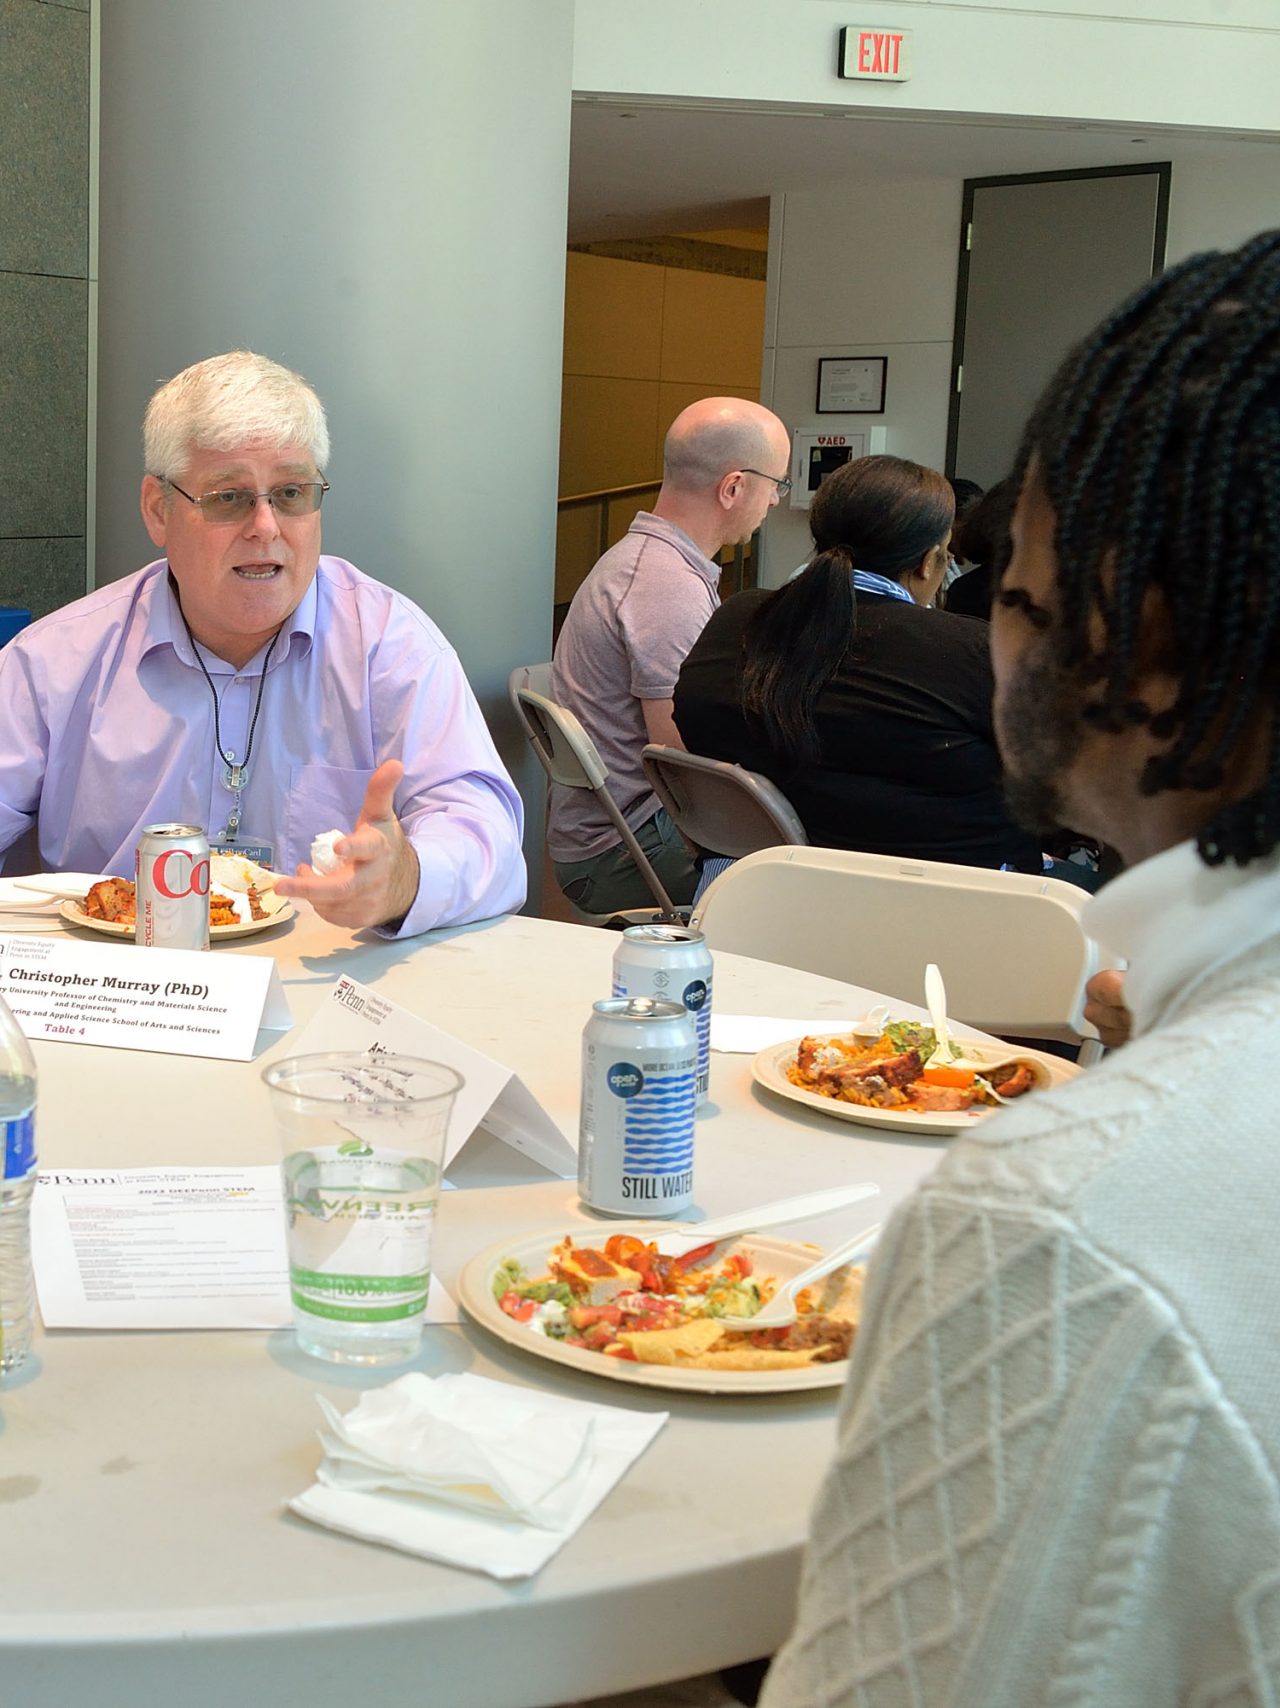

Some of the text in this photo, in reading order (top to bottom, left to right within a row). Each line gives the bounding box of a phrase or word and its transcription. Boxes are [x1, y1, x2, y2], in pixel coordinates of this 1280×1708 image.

[858, 31, 904, 74] EXIT
[826, 436, 846, 445] AED
[146, 900, 152, 912] ME
[9, 968, 209, 1000] Christopher Murray (PhD)
[9, 987, 48, 997] University
[50, 991, 86, 1000] Professor
[97, 995, 138, 1006] Chemistry
[157, 1001, 195, 1010] Materials
[197, 1004, 227, 1013] Science
[342, 985, 365, 1012] Penn
[71, 1002, 117, 1013] Engineering
[44, 1023, 86, 1036] Table 4
[49, 1012, 79, 1021] Applied
[81, 1015, 110, 1023] Science
[112, 1017, 138, 1026] School
[186, 1025, 220, 1034] Sciences
[610, 1075, 639, 1087] open
[53, 1176, 117, 1186] Penn
[622, 1176, 658, 1199] STILL
